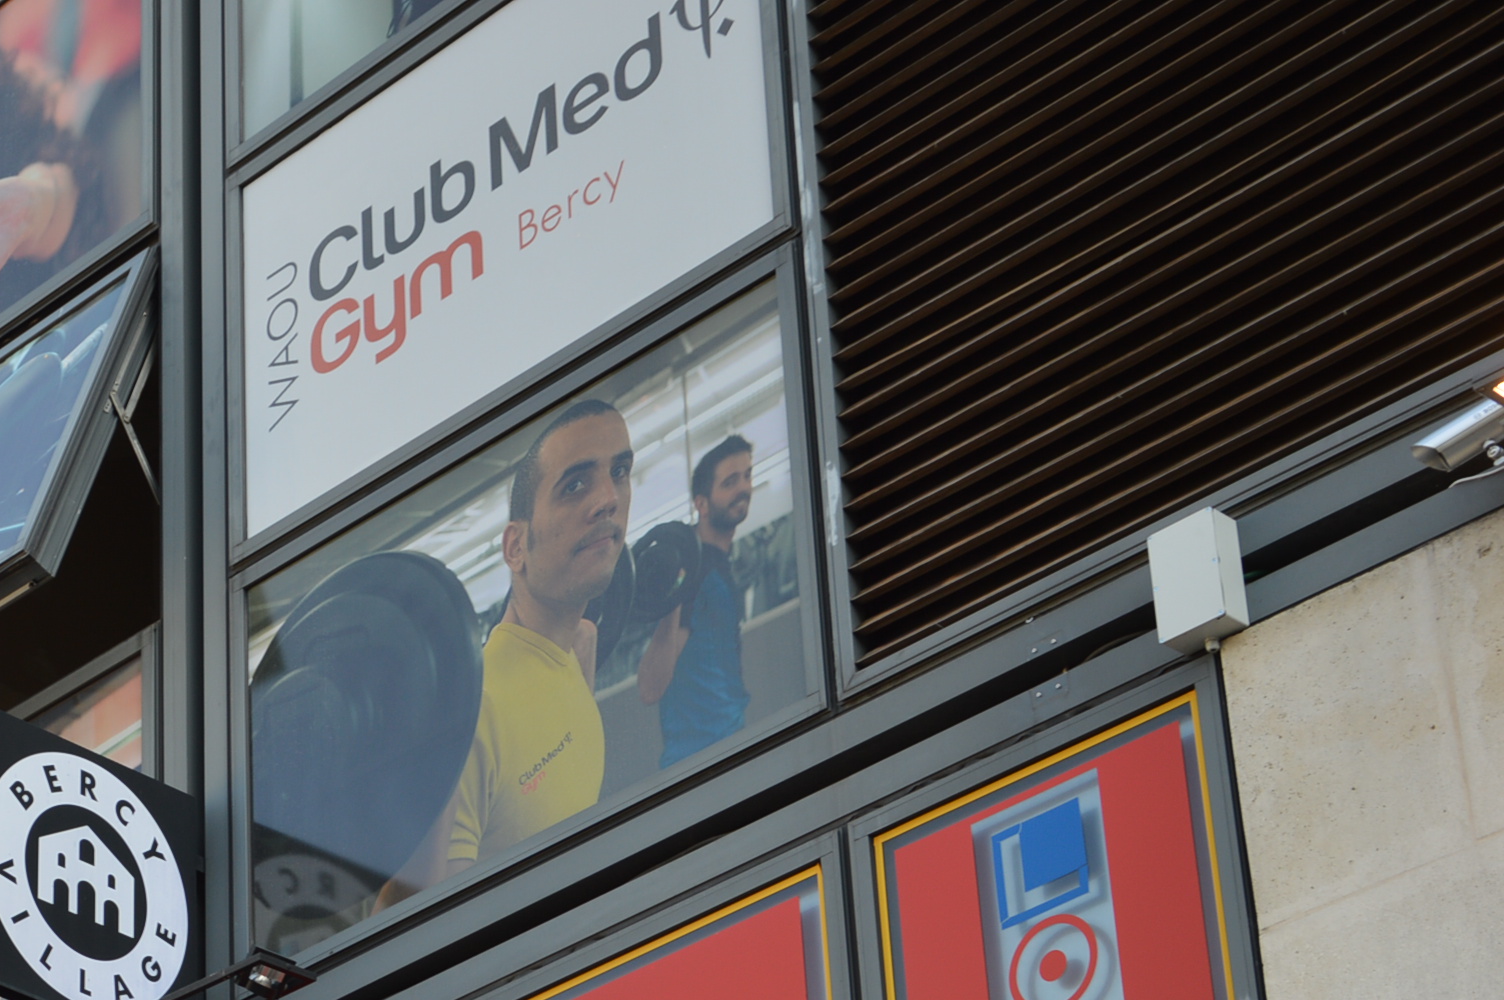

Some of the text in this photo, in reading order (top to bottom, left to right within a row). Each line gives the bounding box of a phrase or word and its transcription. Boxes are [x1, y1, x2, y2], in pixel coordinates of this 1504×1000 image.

[308, 11, 663, 302] Club Med
[517, 160, 626, 250] Bercy
[265, 261, 300, 433] WAOU
[309, 229, 485, 375] Gym
[9, 764, 167, 863] BERCY
